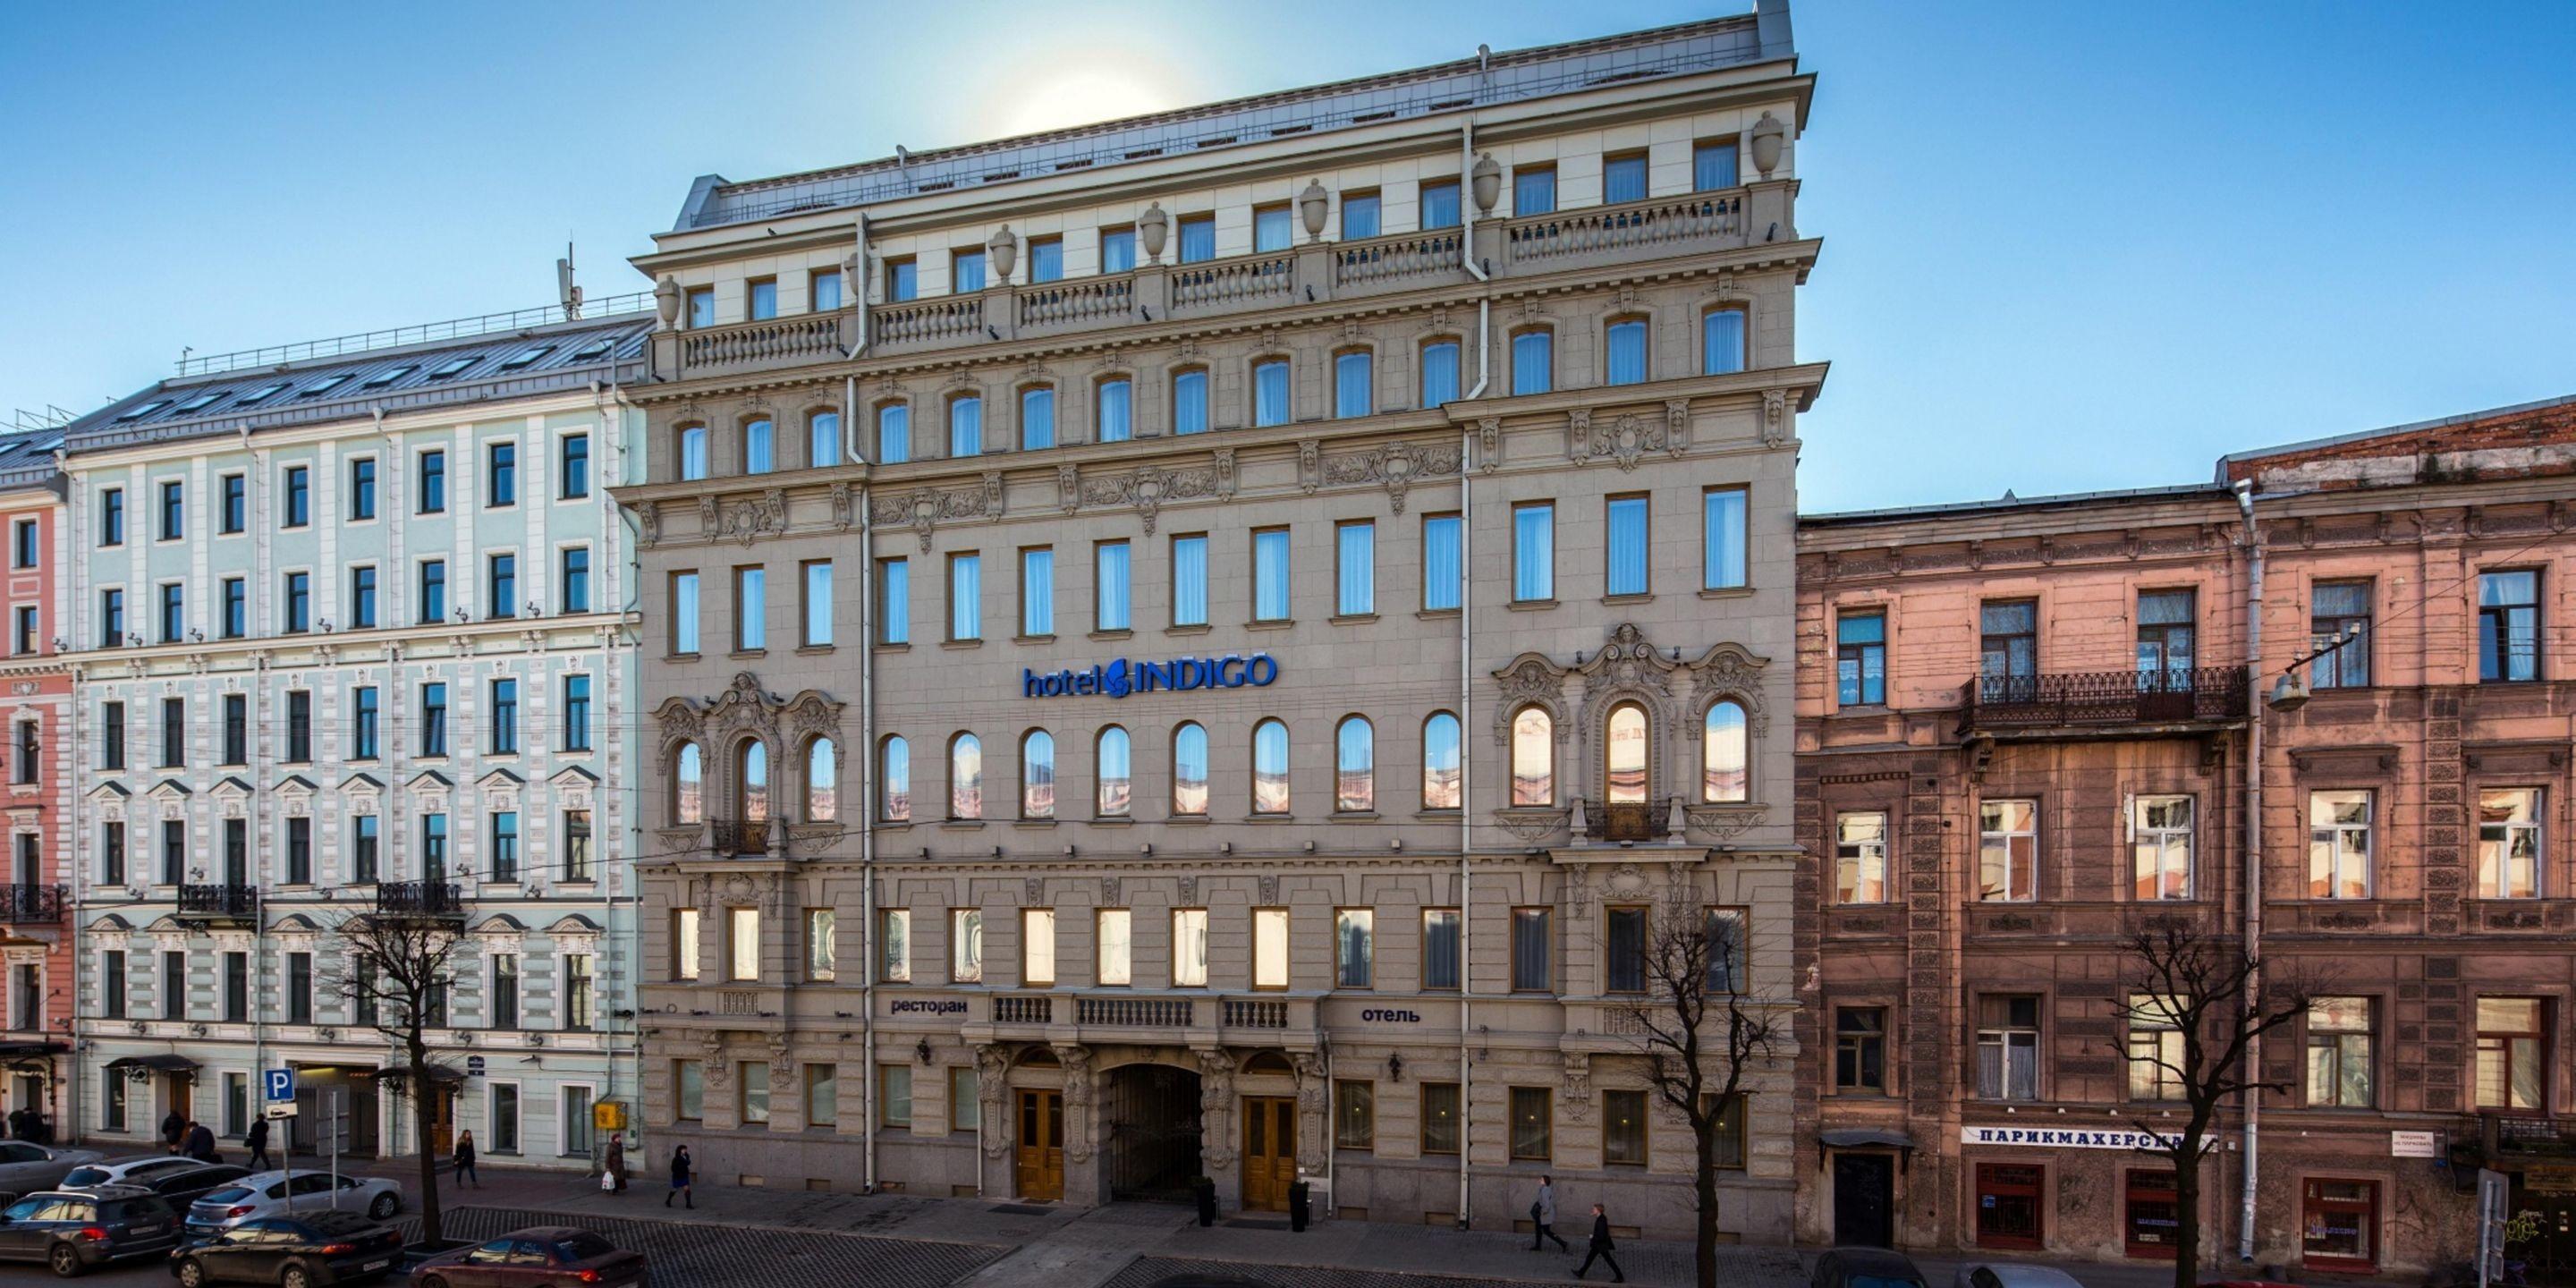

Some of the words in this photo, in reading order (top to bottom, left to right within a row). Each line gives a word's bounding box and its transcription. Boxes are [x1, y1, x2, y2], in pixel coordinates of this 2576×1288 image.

[1023, 664, 1100, 698] hotel
[1134, 655, 1278, 693] INDIGO
[891, 1000, 968, 1016] ресторан
[1362, 1009, 1420, 1022] отель
[273, 1072, 288, 1097] P
[1980, 1130, 2185, 1149] ПАРИКМАХЕРСКА
